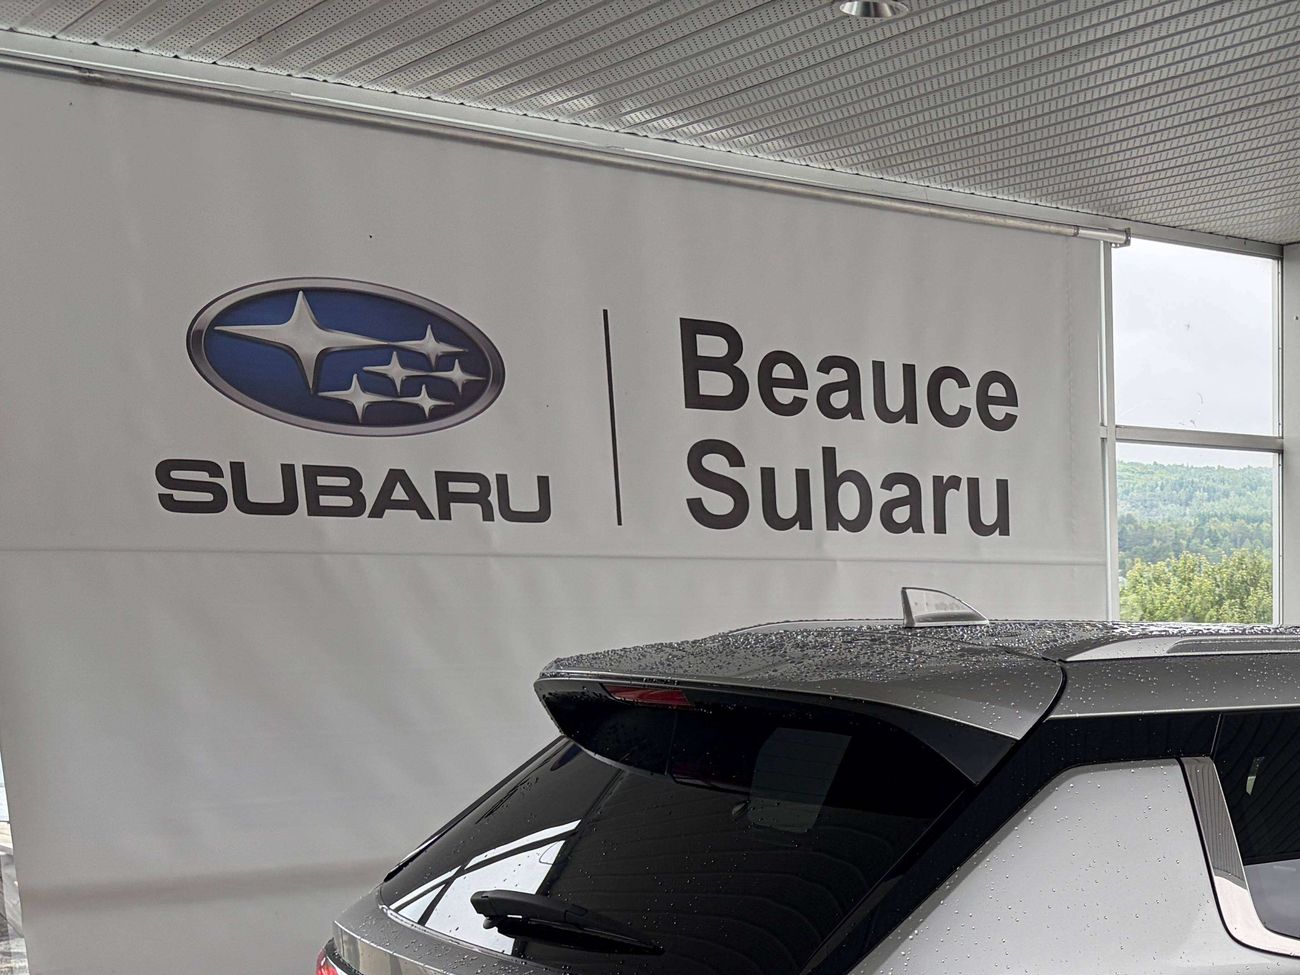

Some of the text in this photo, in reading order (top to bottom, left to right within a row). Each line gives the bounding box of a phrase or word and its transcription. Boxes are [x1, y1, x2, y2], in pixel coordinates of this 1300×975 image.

[679, 317, 1020, 434] Beauce
[155, 459, 552, 524] SUBARU
[685, 439, 1011, 537] Subaru
